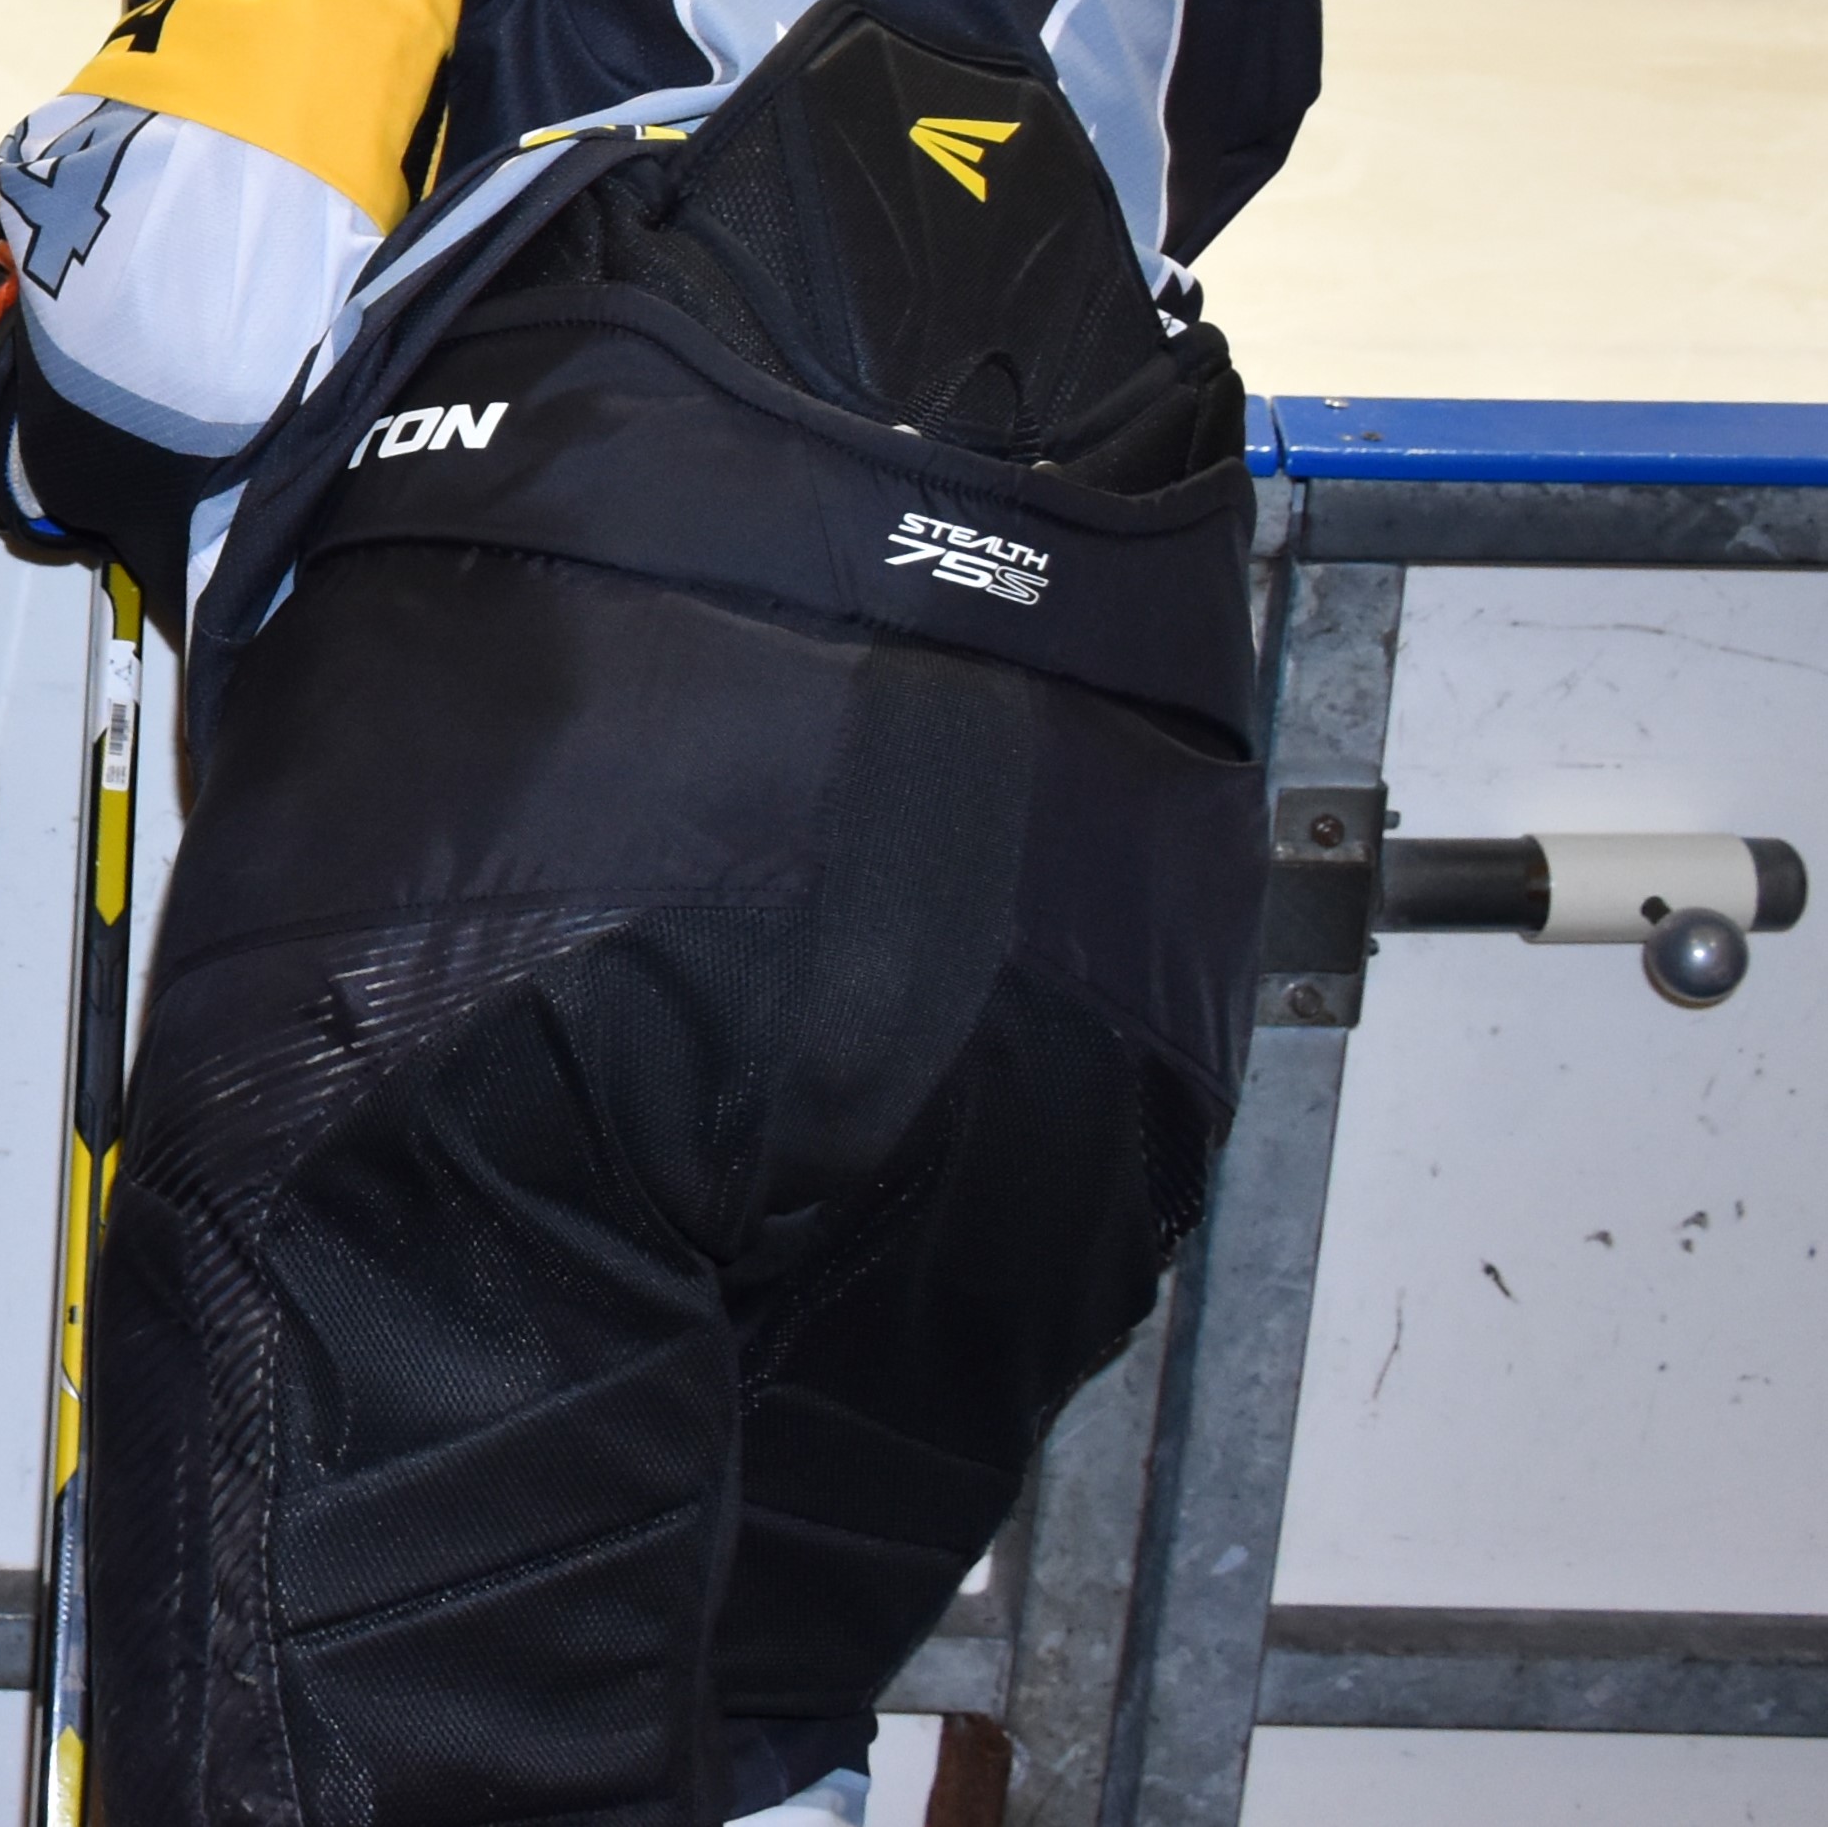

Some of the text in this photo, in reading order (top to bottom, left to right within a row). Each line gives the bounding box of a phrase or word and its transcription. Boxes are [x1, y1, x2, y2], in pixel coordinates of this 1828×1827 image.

[347, 401, 510, 470] TON
[883, 533, 1050, 606] 75S
[897, 512, 1050, 572] STEALTH
